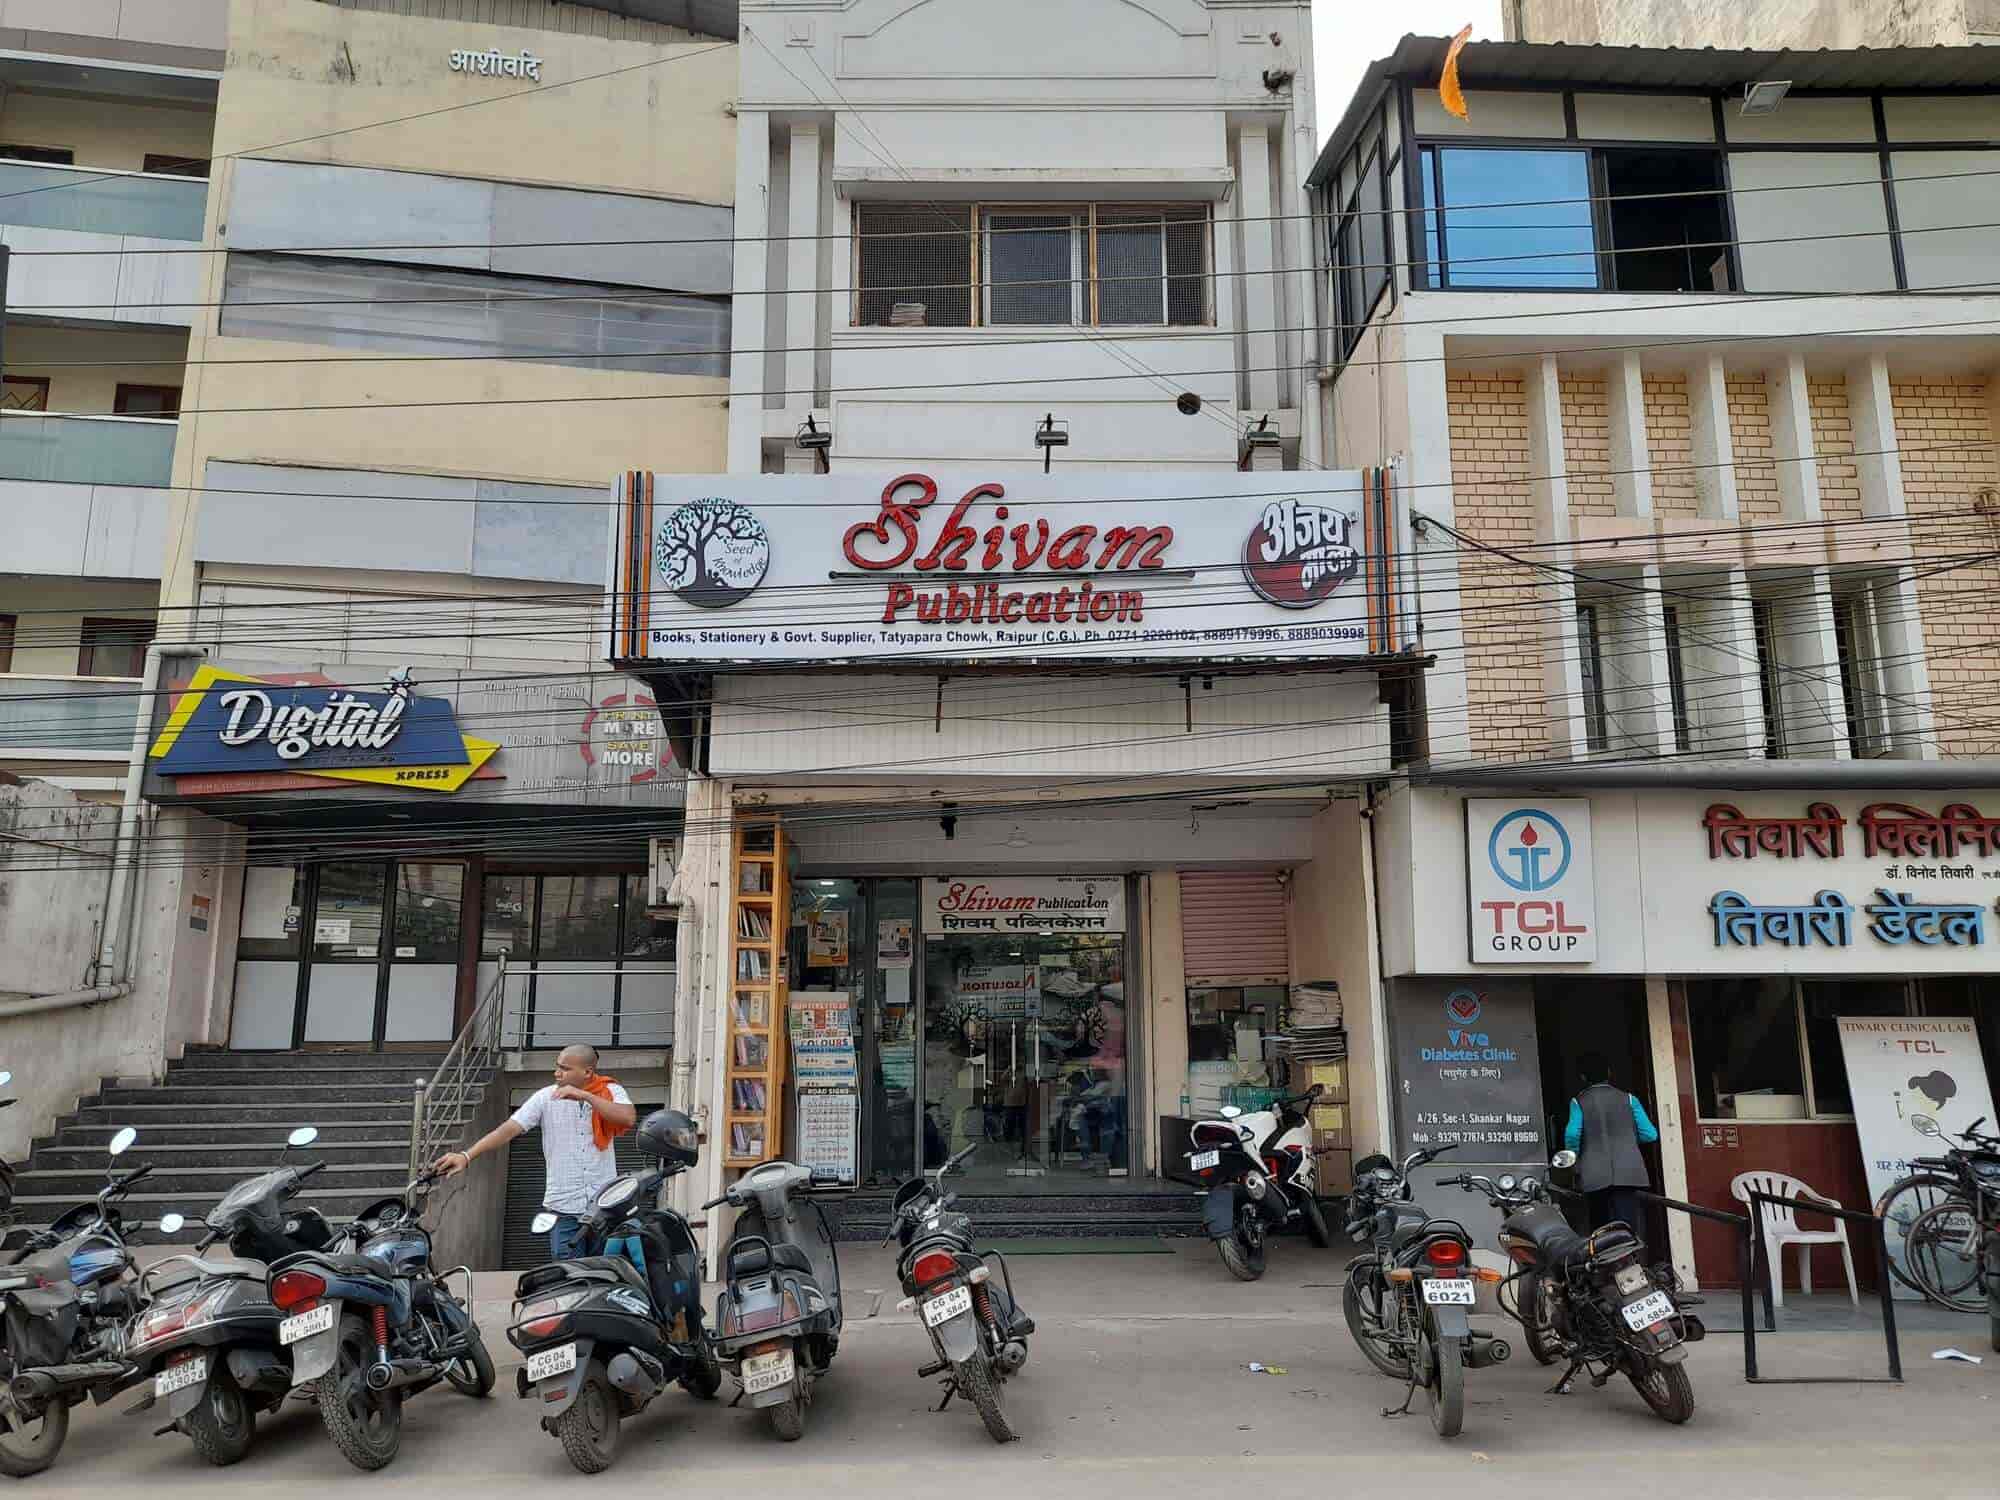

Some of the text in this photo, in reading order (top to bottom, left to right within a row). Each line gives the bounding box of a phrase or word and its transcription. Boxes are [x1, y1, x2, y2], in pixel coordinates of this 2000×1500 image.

[843, 473, 1174, 571] Shivam
[1261, 499, 1346, 562] अजय
[725, 544, 754, 554] Seed
[882, 581, 1144, 625] Publication
[653, 631, 696, 644] Books,
[700, 631, 766, 645] Stationery
[770, 631, 780, 642] &
[784, 631, 817, 643] Govt.
[821, 631, 876, 645] Supplier,
[880, 631, 942, 645] Tatyapara
[947, 630, 992, 644] Chowk,
[997, 630, 1037, 644] Raipur
[219, 685, 406, 760] Digital
[602, 752, 655, 766] MORE
[396, 768, 450, 781] XPRESS
[1703, 802, 2000, 858] तिवारी क्लिनि
[1906, 865, 1937, 879] विनोद
[1940, 864, 1975, 879] तिवारी
[938, 883, 1109, 911] Shivam Publication
[1005, 913, 1106, 929] पब्लिकेशन
[1480, 901, 1587, 933] TCL
[1707, 889, 1856, 946] तिवारी
[1492, 936, 1577, 951] GROUP
[1891, 1023, 1948, 1032] CLINICAL
[1949, 1024, 1971, 1033] LAB
[1448, 1029, 1489, 1046] Viva
[1897, 1040, 1947, 1053] TCL
[1421, 1048, 1519, 1061] Diabetes Clinic
[1506, 1113, 1530, 1127] Nagar
[932, 1298, 946, 1309] CG
[1428, 1291, 1471, 1301] 6021
[1630, 1295, 1659, 1314] CG 04
[537, 1351, 566, 1367] CG 04
